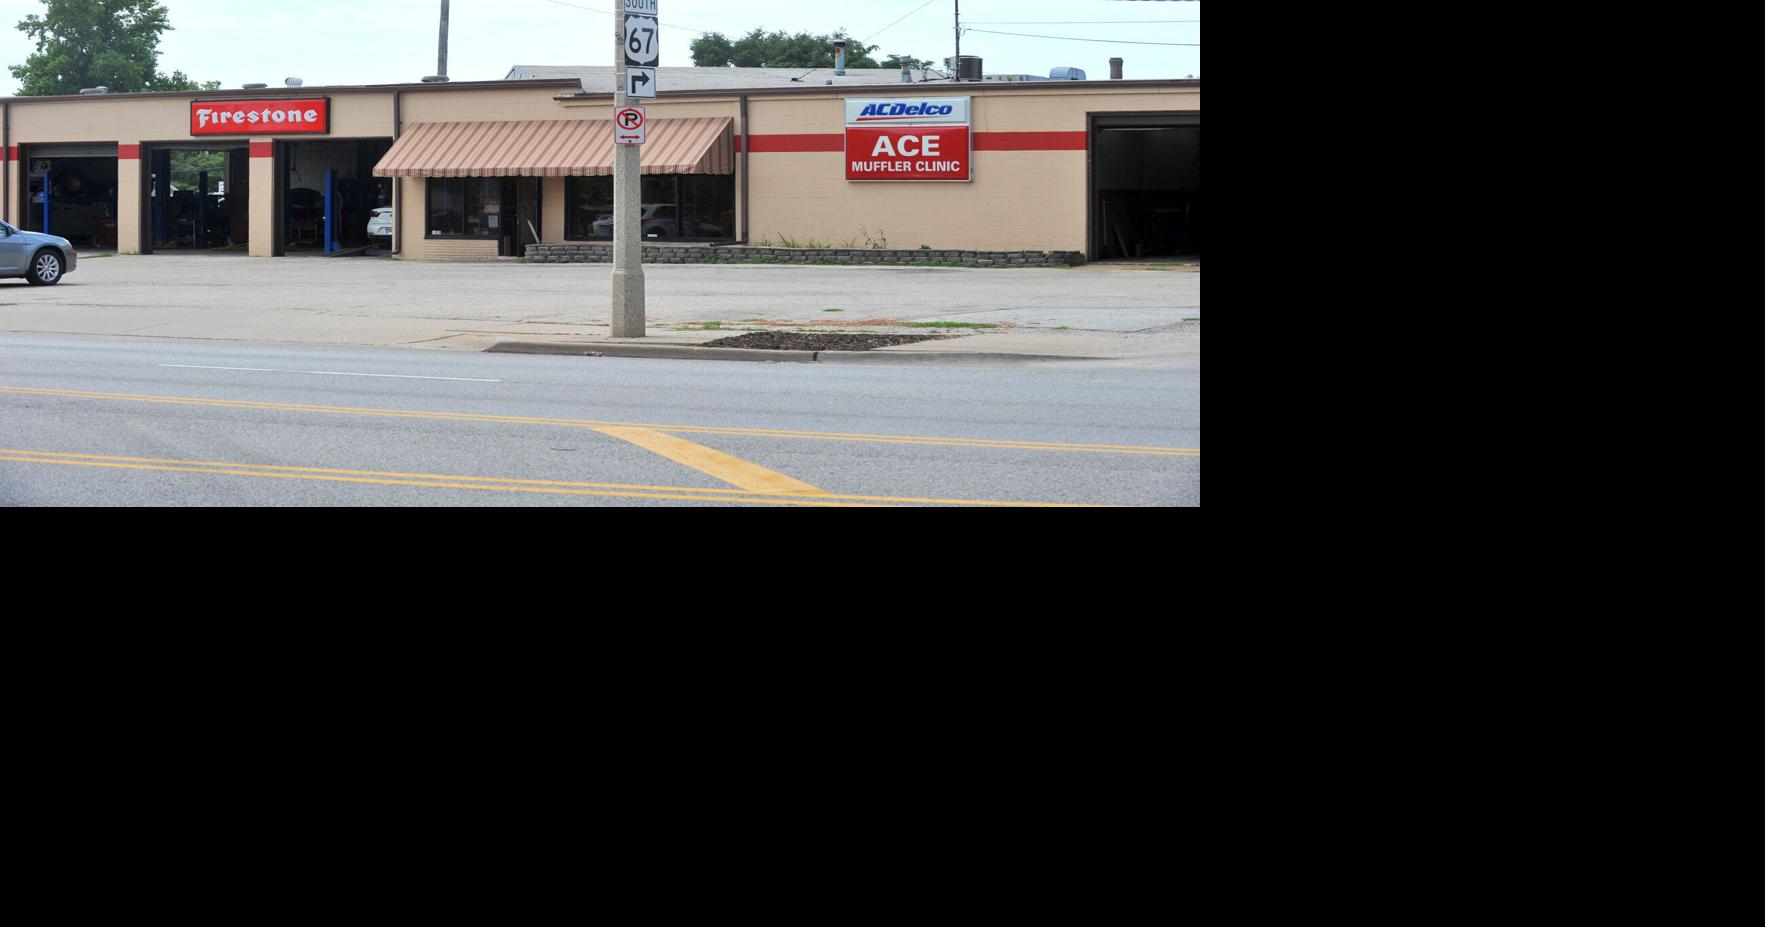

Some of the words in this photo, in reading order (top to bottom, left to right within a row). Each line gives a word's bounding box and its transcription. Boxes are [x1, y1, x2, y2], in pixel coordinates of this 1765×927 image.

[629, 27, 654, 54] 67
[196, 108, 318, 128] Firestone
[860, 102, 953, 116] ACDelco
[871, 135, 940, 157] ACE
[851, 161, 912, 172] MUFFLER
[915, 161, 960, 172] CLINIC
